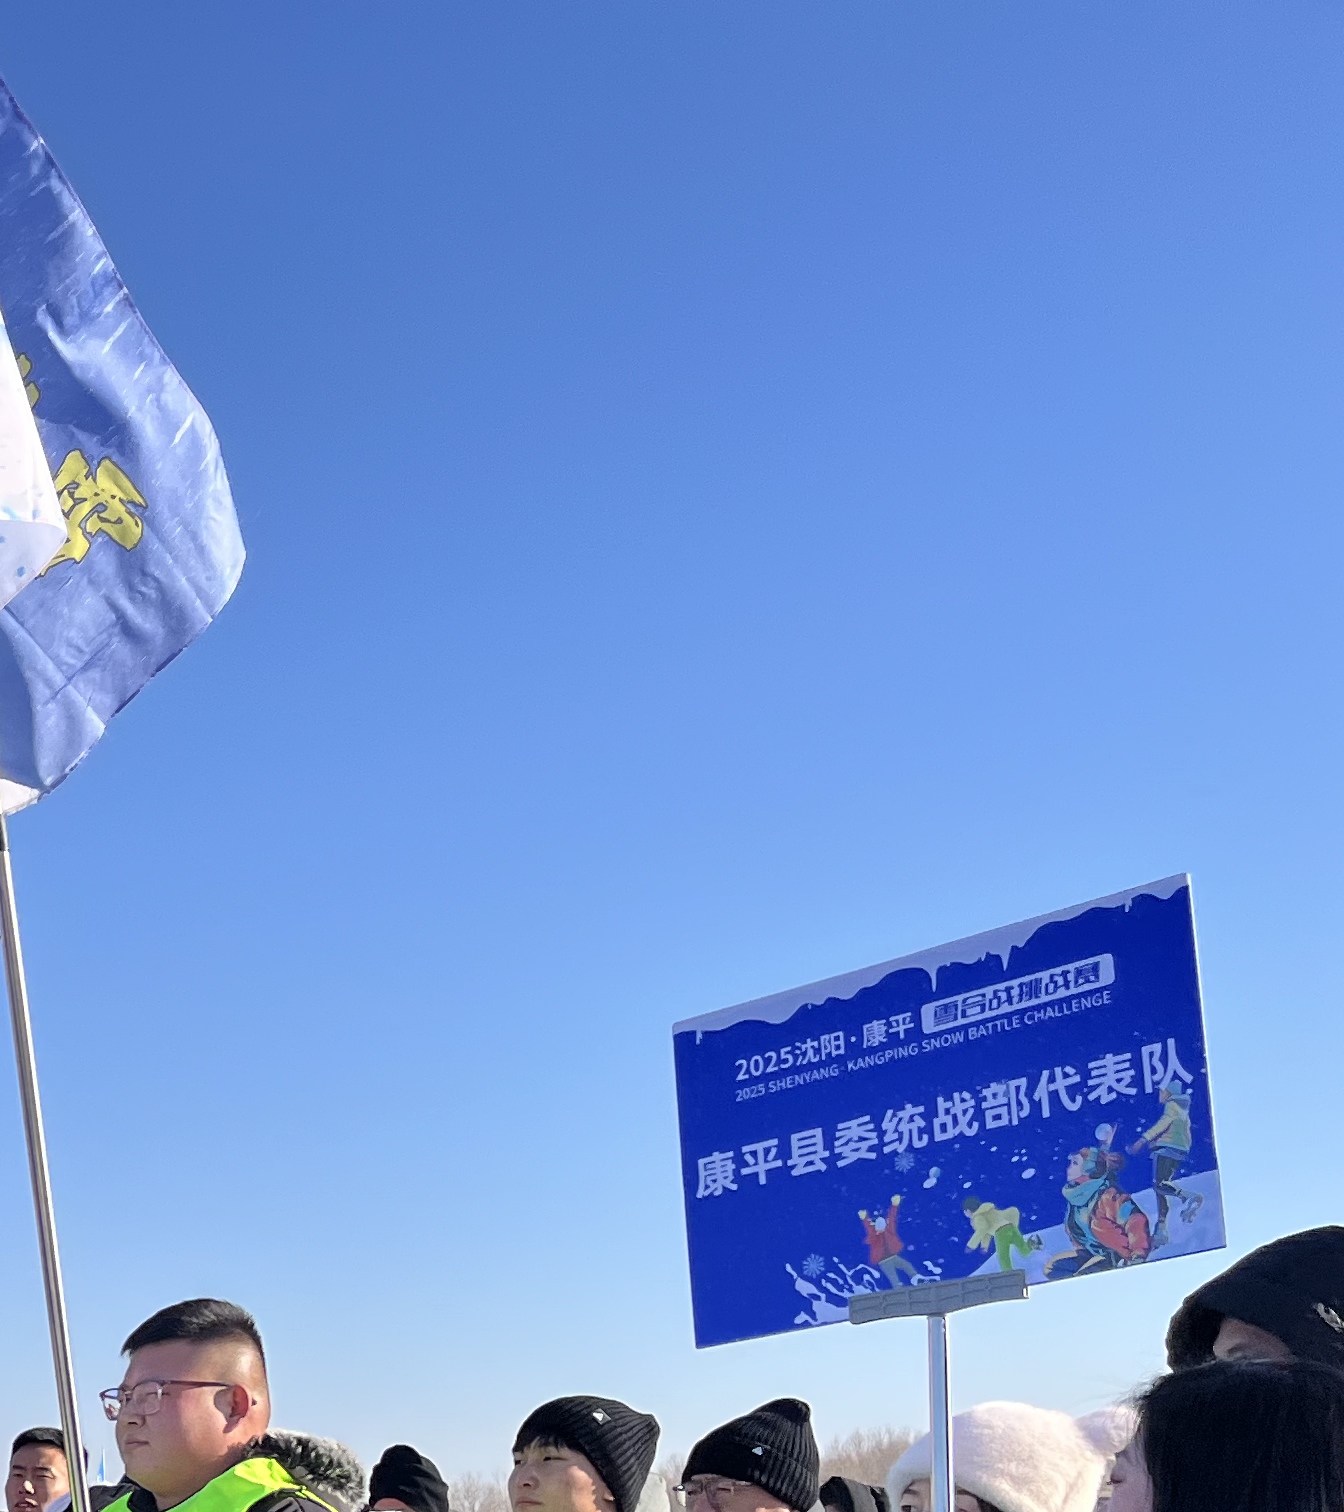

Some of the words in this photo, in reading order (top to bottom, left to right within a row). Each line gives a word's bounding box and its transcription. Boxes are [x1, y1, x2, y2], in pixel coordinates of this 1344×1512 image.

[735, 1083, 766, 1102] 2025
[921, 1030, 964, 1052] SNOW
[968, 1015, 1020, 1040] BATTLE
[1024, 990, 1111, 1026] CHALLENGE
[695, 1037, 1194, 1199] 康平县委统战部代表队
